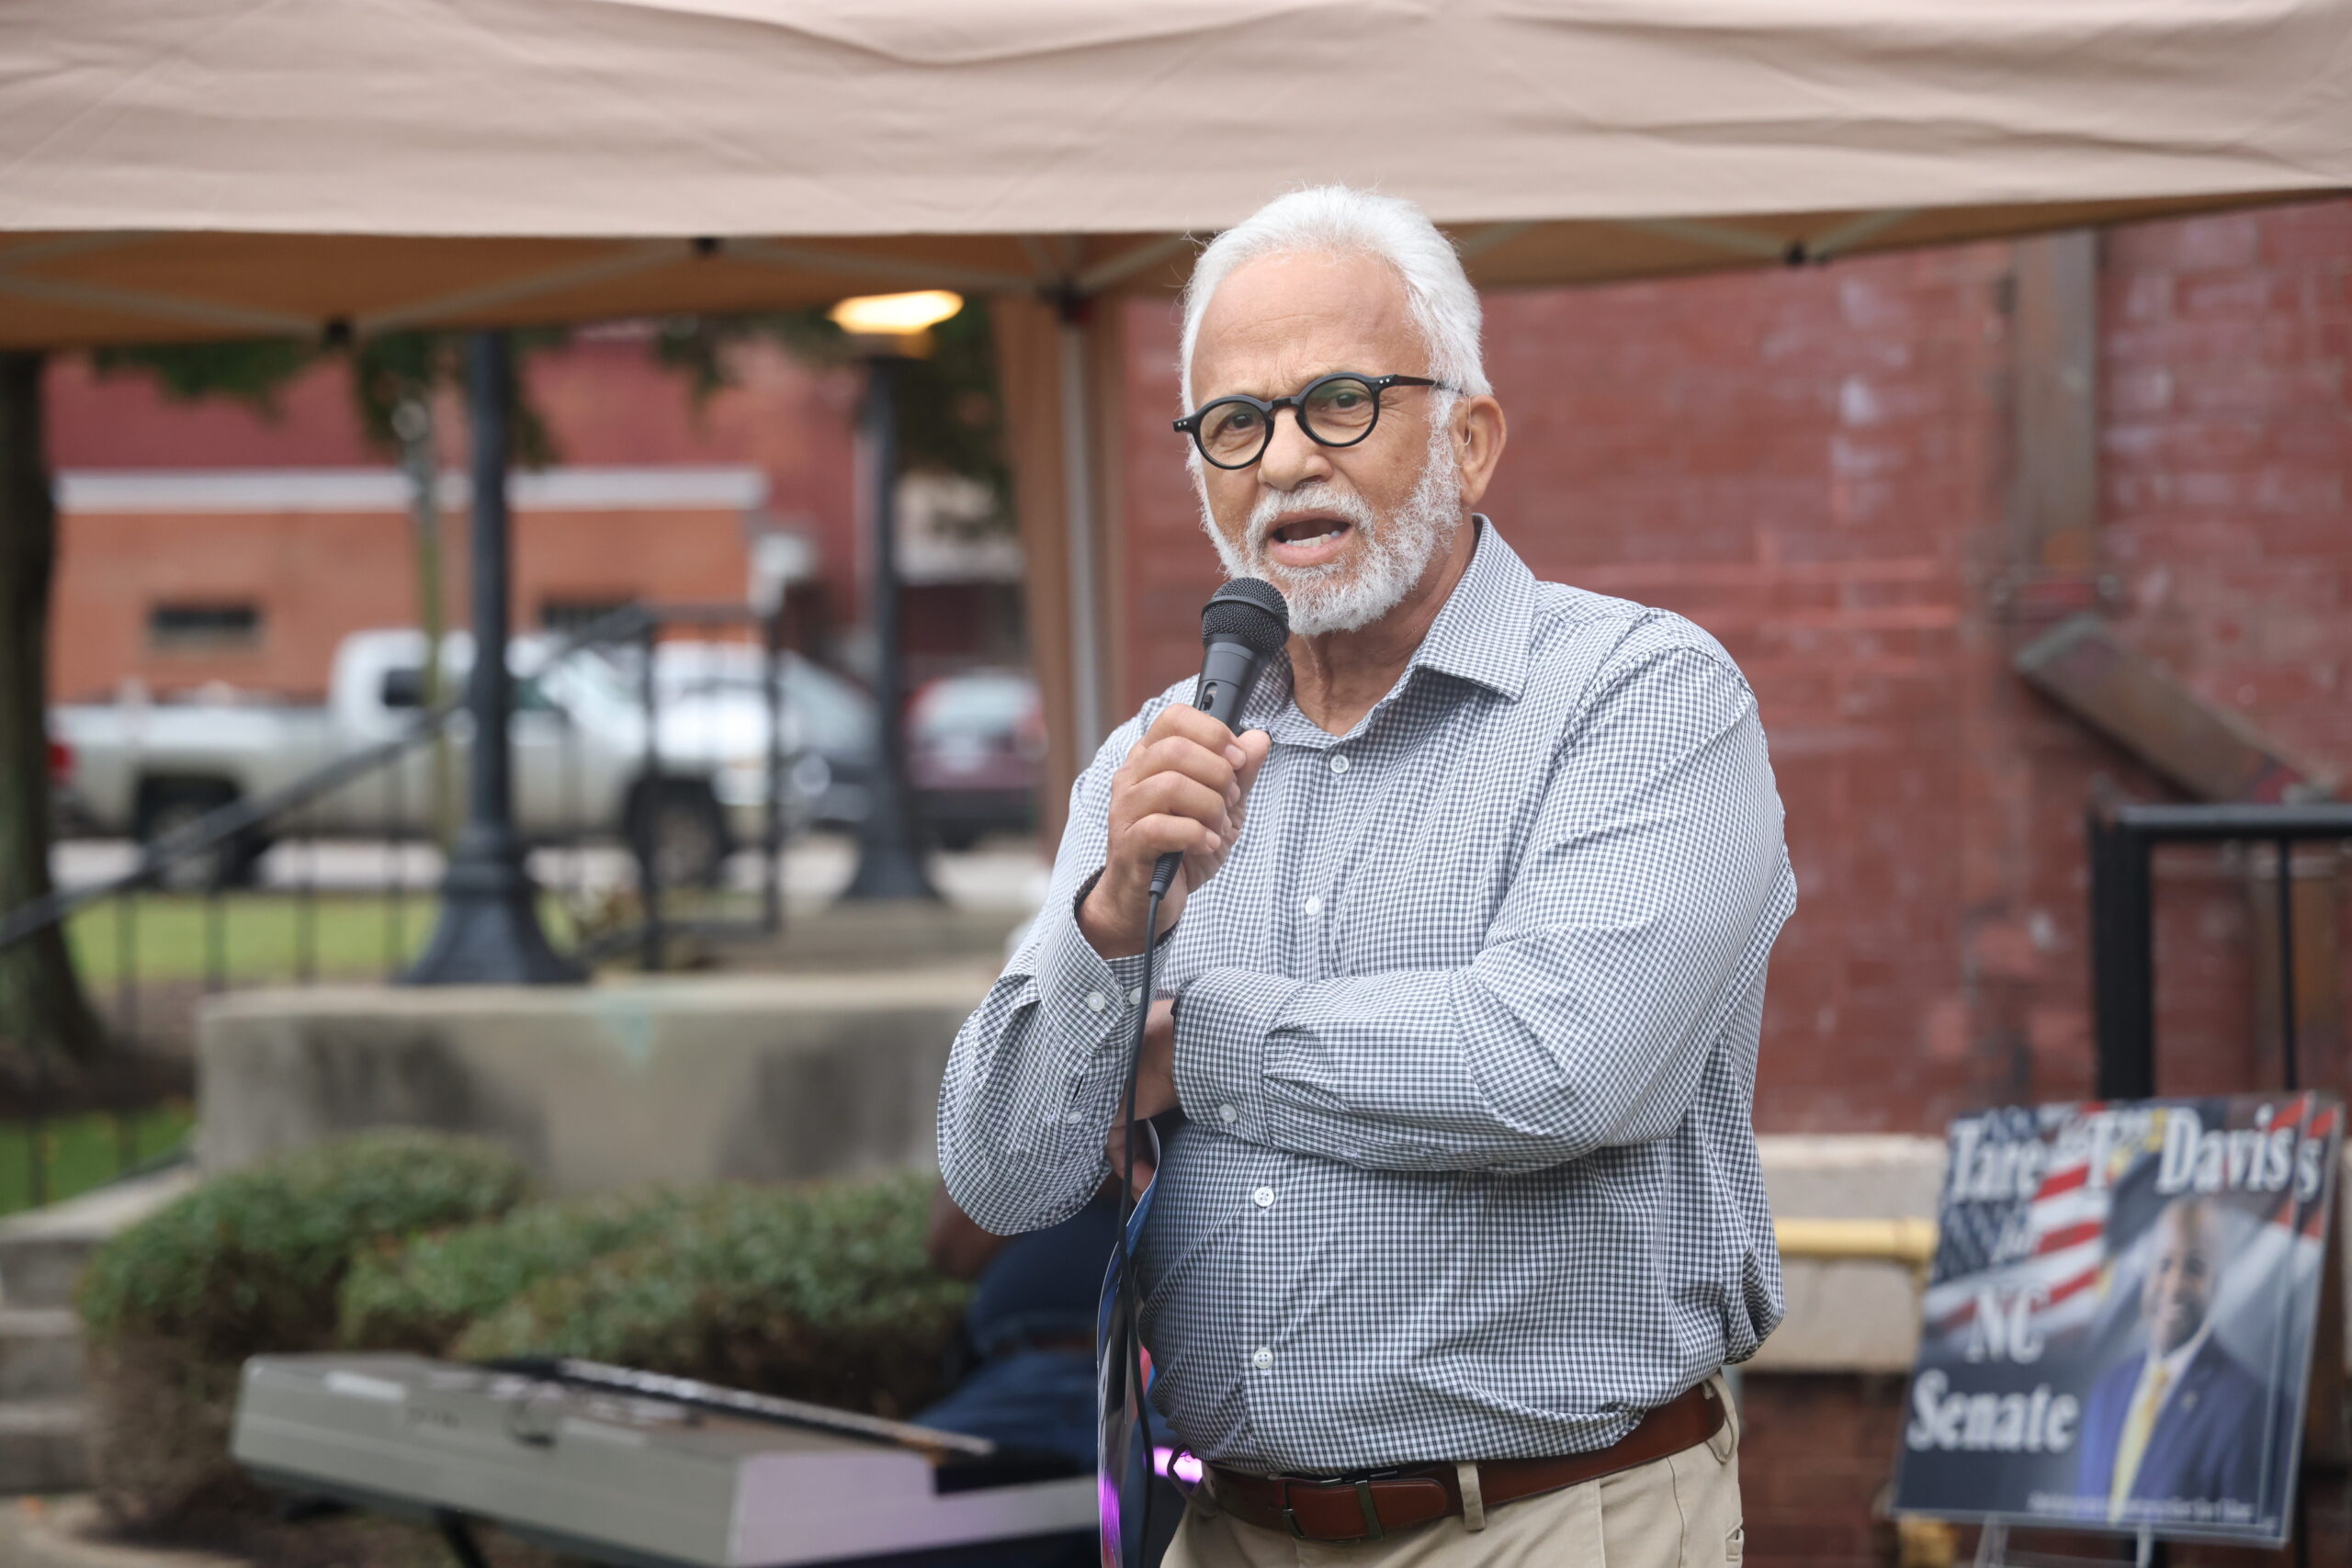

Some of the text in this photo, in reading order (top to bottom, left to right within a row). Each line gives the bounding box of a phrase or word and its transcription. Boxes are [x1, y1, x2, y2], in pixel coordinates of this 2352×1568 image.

[2154, 1102, 2295, 1195] Davis
[1965, 1288, 2049, 1365] NC
[1905, 1369, 2080, 1453] Senate
